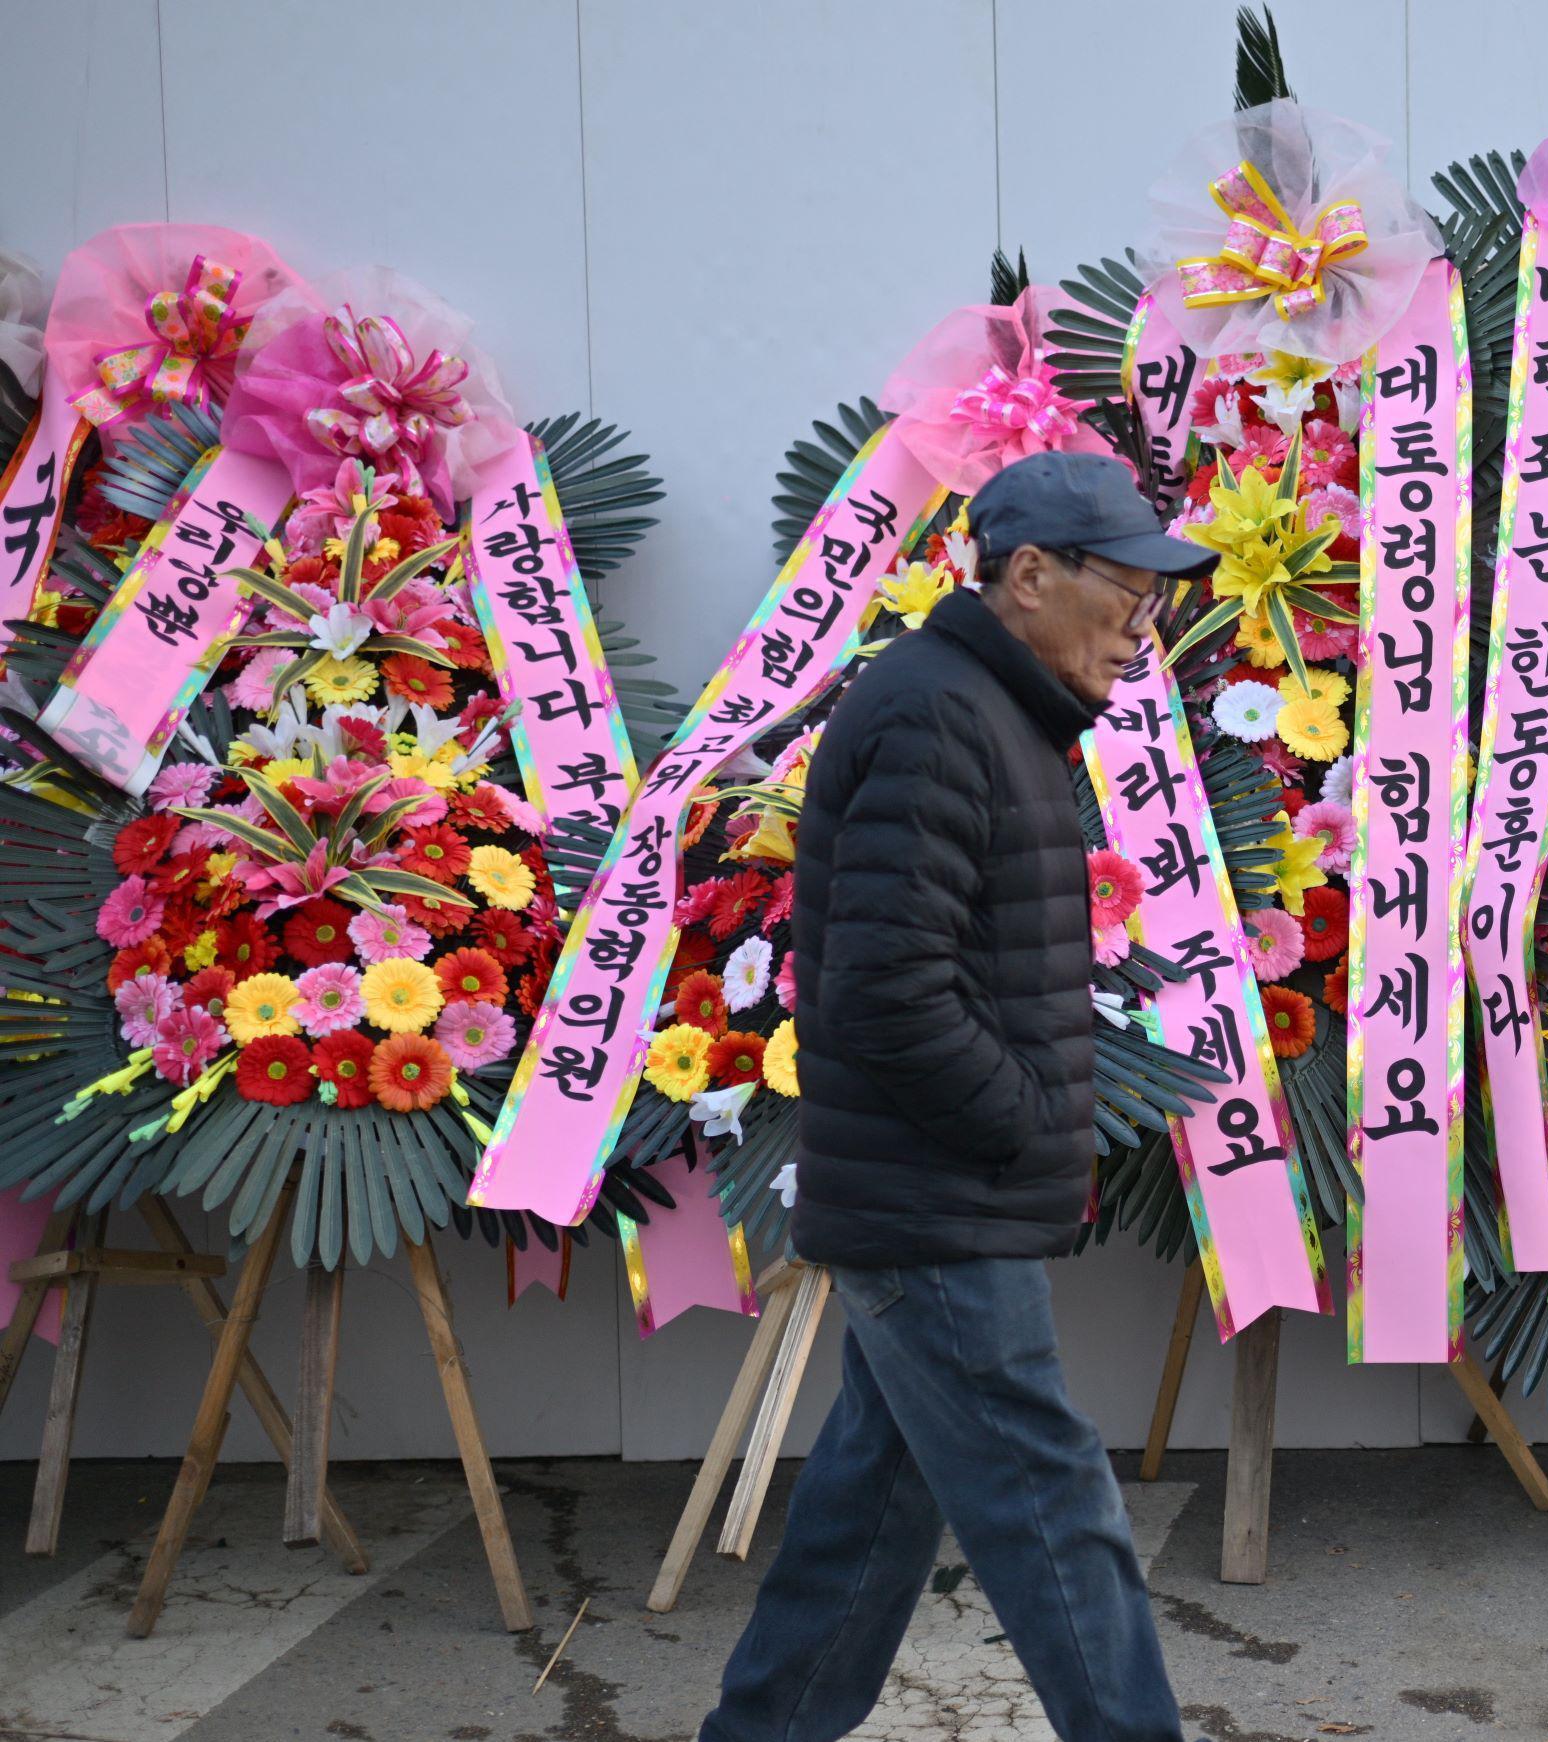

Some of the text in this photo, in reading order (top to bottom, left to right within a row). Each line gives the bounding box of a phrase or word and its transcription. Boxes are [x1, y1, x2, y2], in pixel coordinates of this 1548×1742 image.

[484, 483, 604, 730] 사랑합니다
[760, 489, 897, 688] 국민의힘
[645, 697, 774, 797] 최고위
[1363, 345, 1449, 1141] 대통령님 힘내세요
[1102, 698, 1288, 1178] 바라봐 주세요
